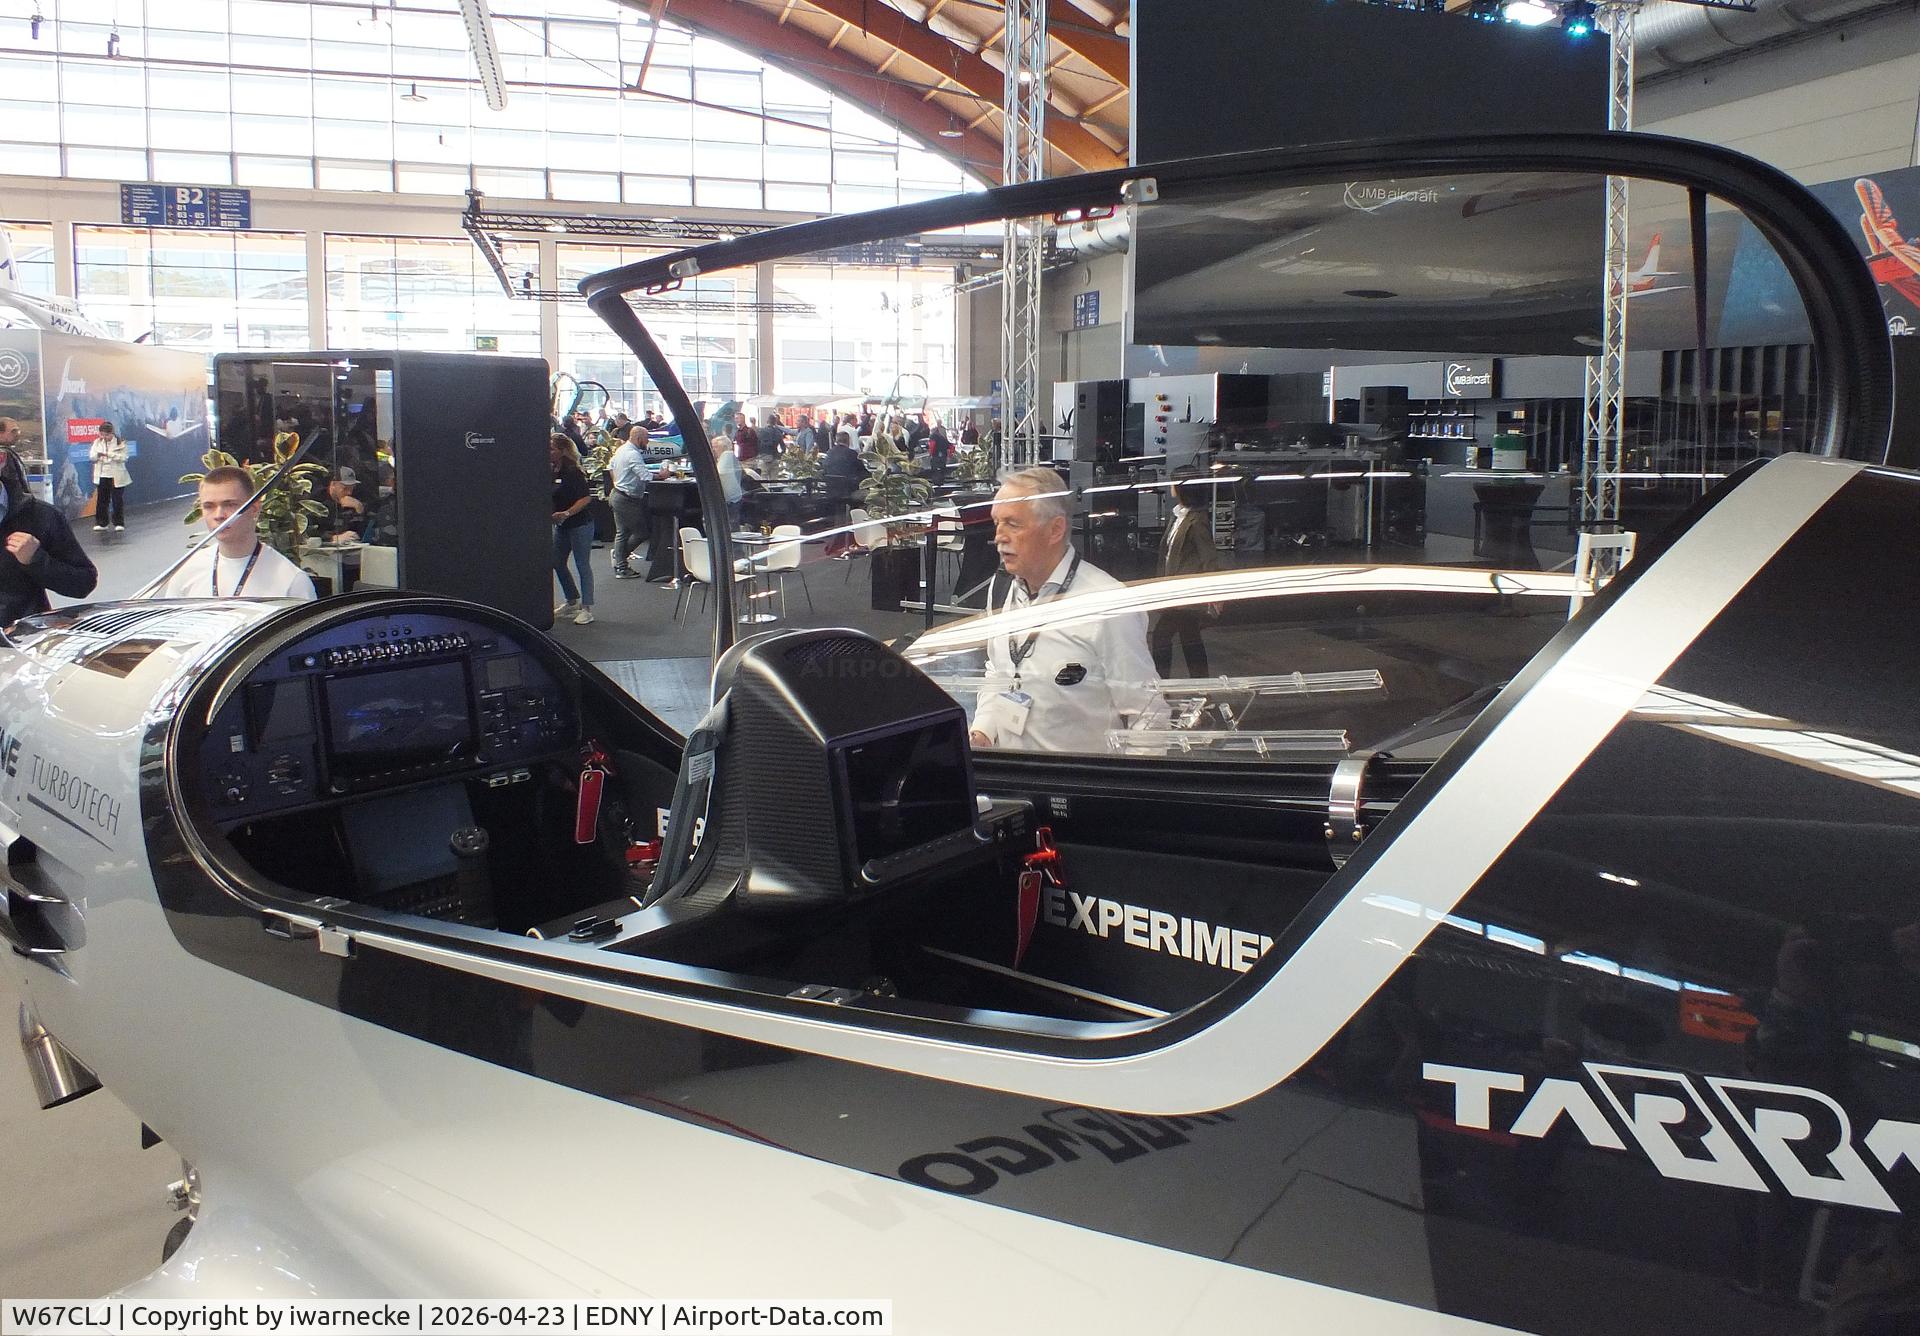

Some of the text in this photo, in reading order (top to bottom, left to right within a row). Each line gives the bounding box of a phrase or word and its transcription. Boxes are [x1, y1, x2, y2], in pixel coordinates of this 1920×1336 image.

[176, 188, 204, 205] B2
[1357, 187, 1438, 203] JMB aircraft
[32, 753, 121, 836] TURBOTECH
